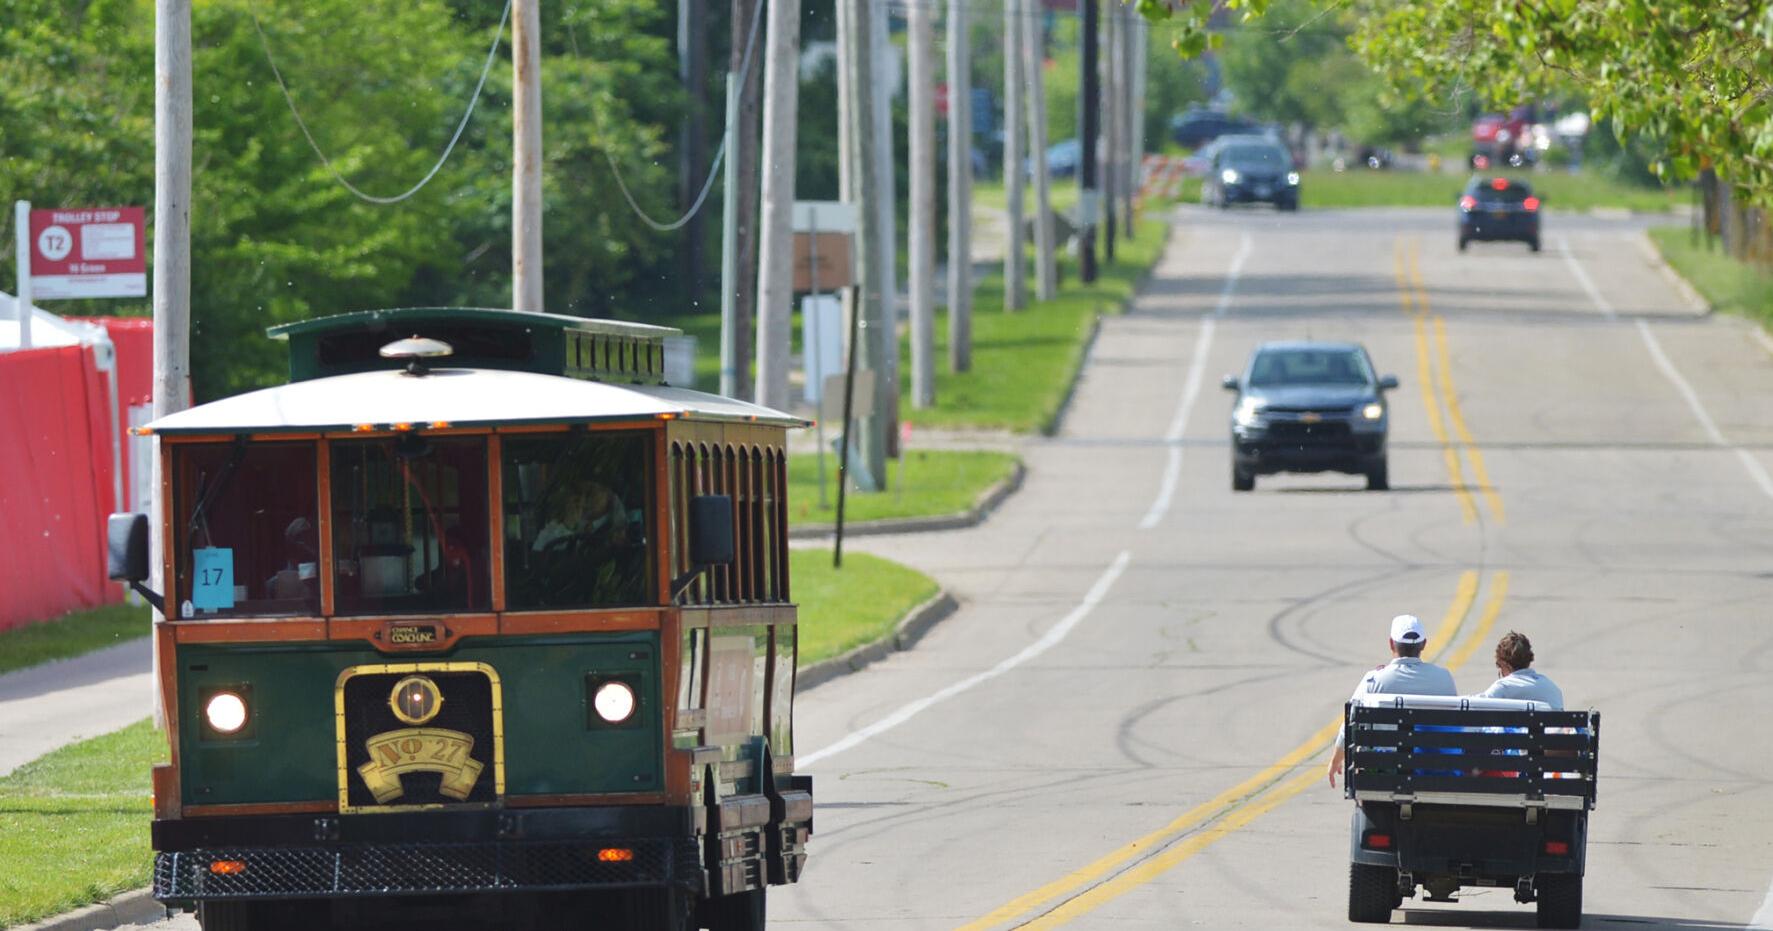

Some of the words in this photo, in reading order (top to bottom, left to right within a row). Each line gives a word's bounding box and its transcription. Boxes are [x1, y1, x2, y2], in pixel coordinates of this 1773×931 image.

[53, 212, 93, 223] TROLLEY
[94, 211, 120, 222] STOP
[46, 235, 64, 250] T2
[202, 568, 223, 586] 17
[431, 739, 467, 762] 27
